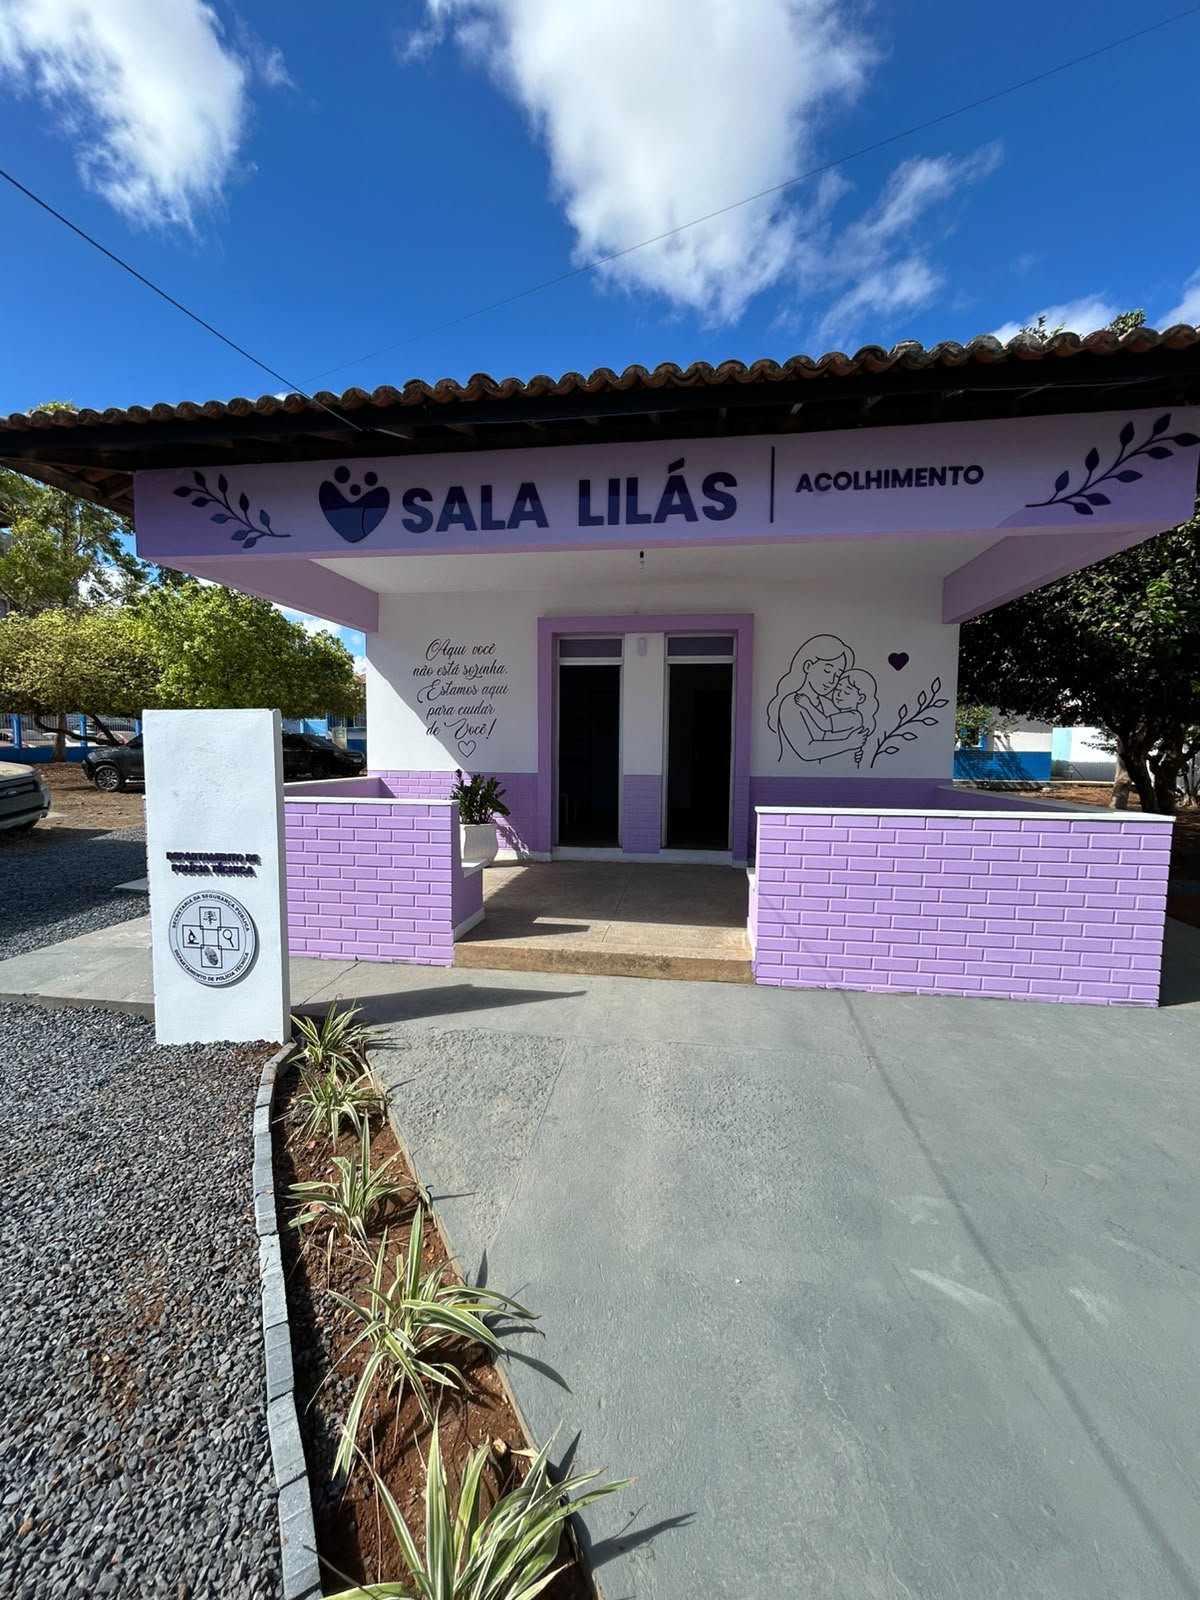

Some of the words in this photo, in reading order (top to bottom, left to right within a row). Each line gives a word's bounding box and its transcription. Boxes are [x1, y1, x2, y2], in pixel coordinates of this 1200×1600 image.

[795, 464, 984, 493] ACOLHIMENTO
[402, 482, 549, 534] SALA
[578, 457, 738, 526] LILÁS
[425, 638, 467, 661] Aqui
[472, 643, 497, 656] você
[412, 665, 434, 677] não
[437, 660, 460, 676] está
[463, 659, 508, 680] sozinha.
[417, 679, 478, 703] Estamos
[481, 684, 508, 699] aqui
[426, 705, 455, 720] para
[458, 700, 495, 715] cuidar
[426, 720, 440, 736] de
[166, 852, 244, 862] DEPARTAMENTO
[246, 853, 259, 863] DE
[171, 861, 210, 873] POLÍCIA
[211, 862, 254, 874] TÉCNICA
[172, 898, 194, 929] SECRETARIA
